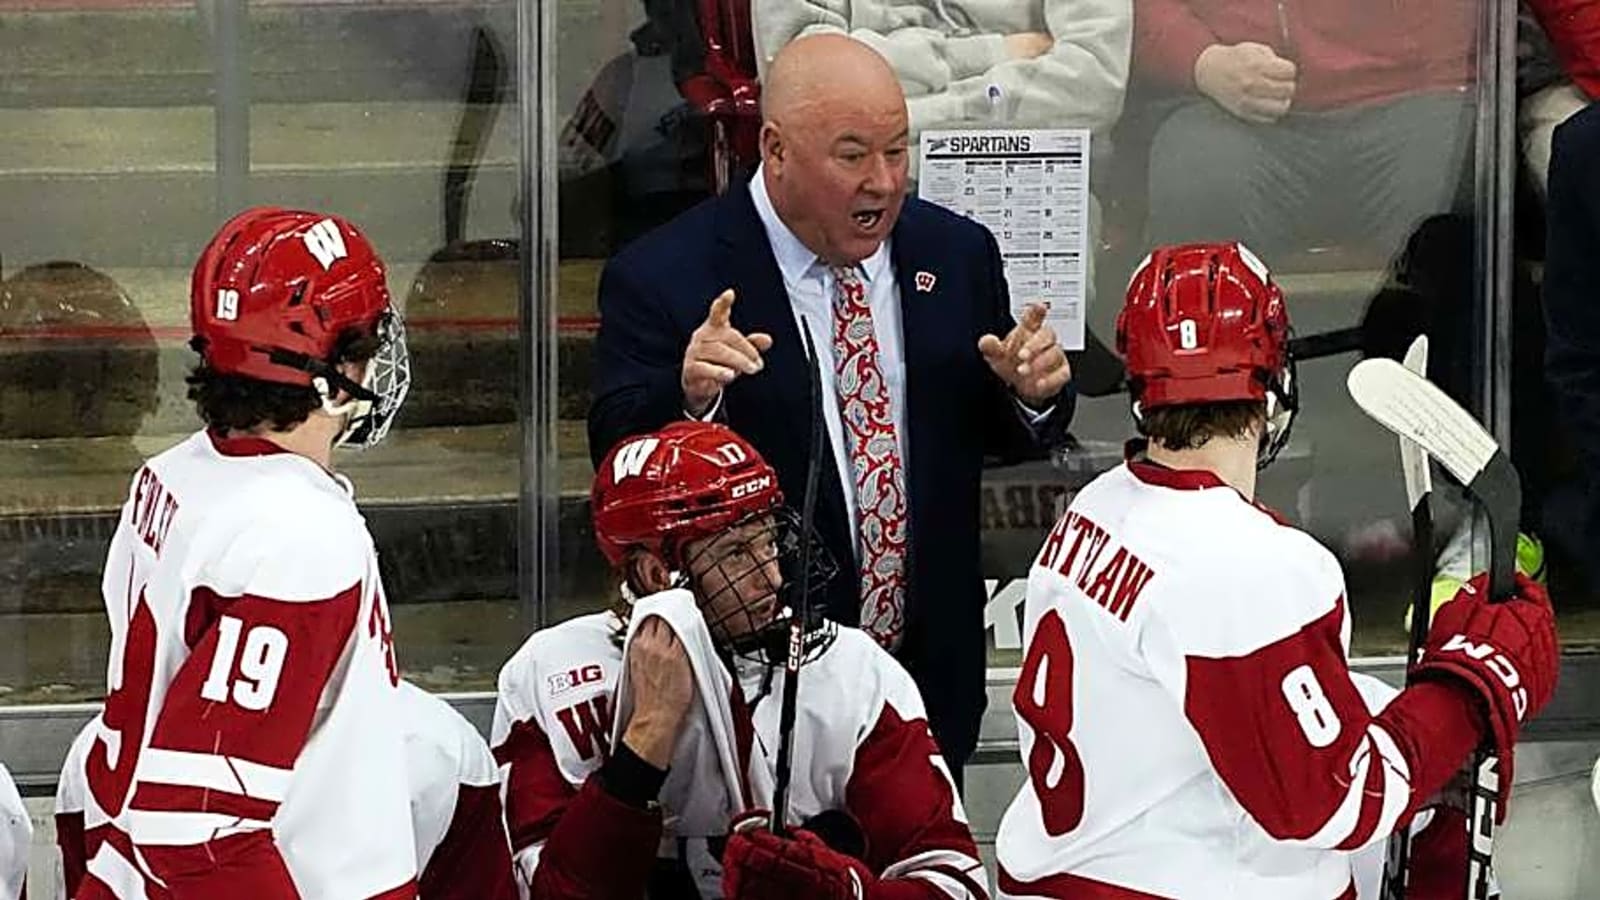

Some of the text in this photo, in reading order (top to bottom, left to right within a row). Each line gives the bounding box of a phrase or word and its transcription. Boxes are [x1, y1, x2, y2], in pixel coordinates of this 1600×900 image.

[949, 135, 1031, 152] SPARTANS
[303, 218, 348, 271] W
[216, 289, 239, 320] 19
[1179, 319, 1197, 349] 8
[612, 438, 660, 485] W
[731, 475, 771, 498] CCM
[200, 615, 289, 712] 19
[788, 625, 800, 671] CCM
[1440, 634, 1528, 722] CCM
[1281, 664, 1342, 748] 8
